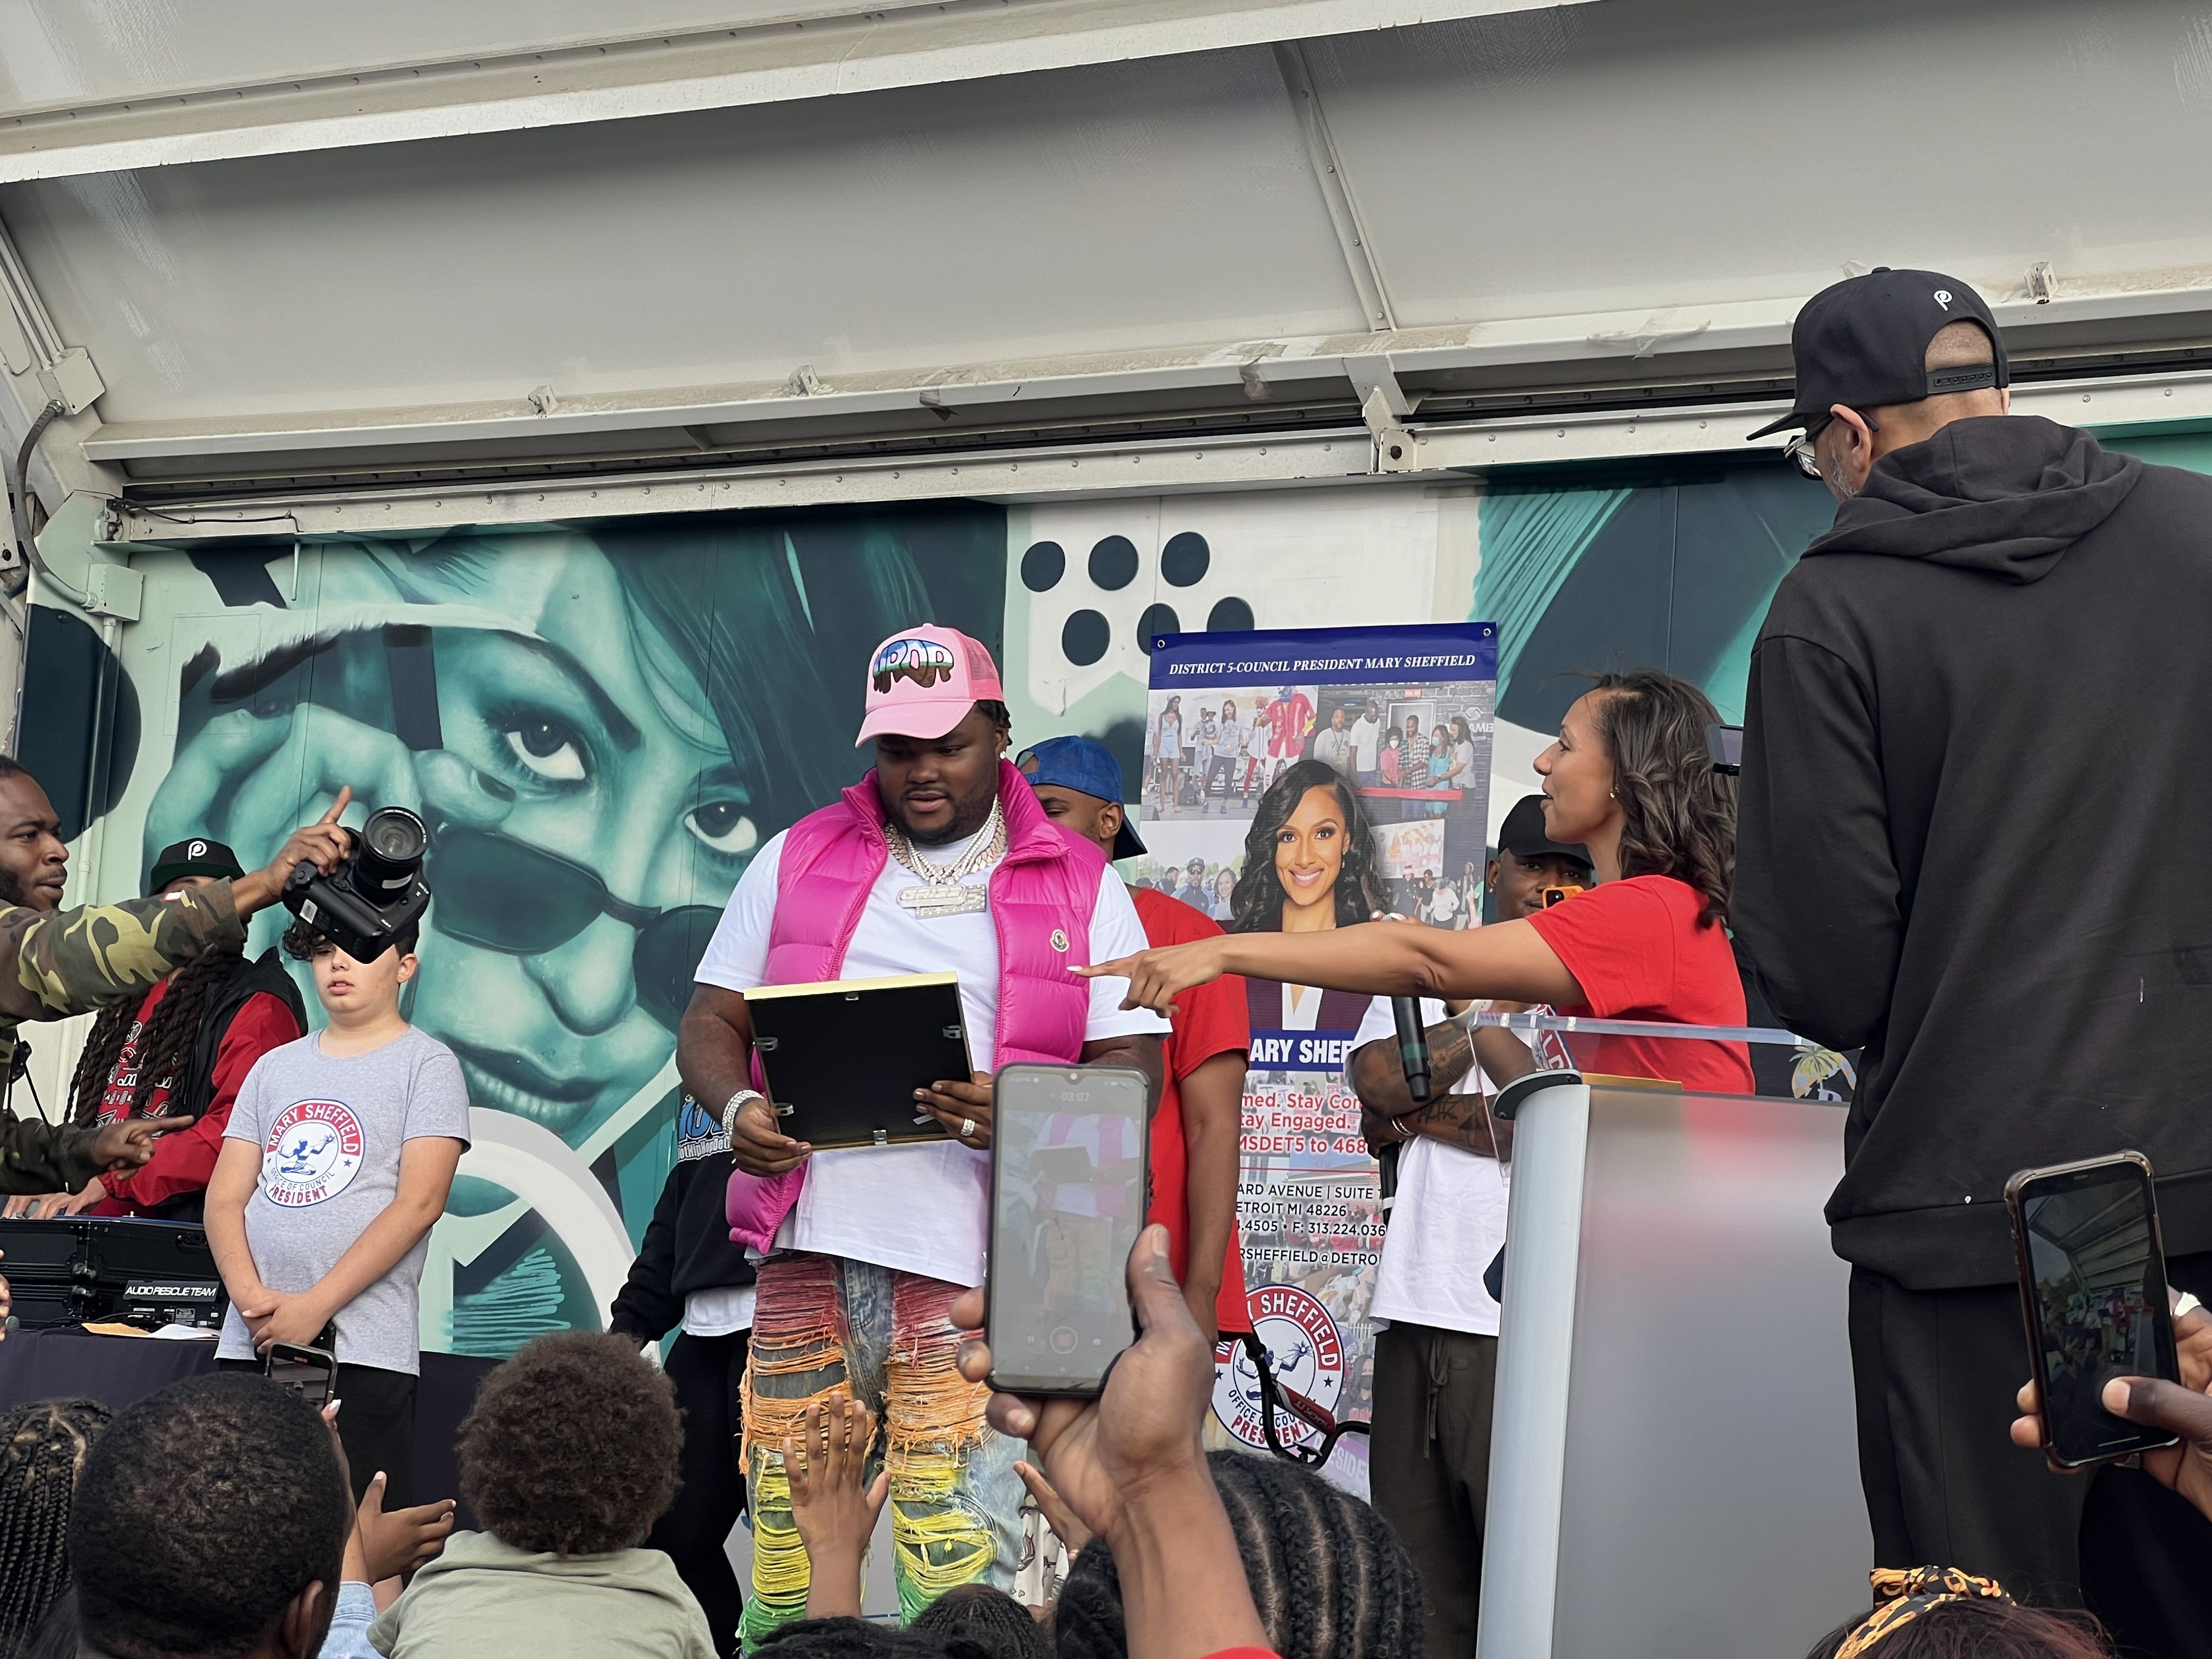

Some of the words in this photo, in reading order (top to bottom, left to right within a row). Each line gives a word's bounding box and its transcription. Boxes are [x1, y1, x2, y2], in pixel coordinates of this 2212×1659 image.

[1169, 662, 1226, 674] DISTRICT
[1227, 661, 1290, 673] 5-COUNCIL
[1293, 658, 1363, 671] PRESIDENT
[1364, 657, 1402, 669] MARY
[1404, 654, 1476, 668] SHEFFIELD
[1249, 1039, 1294, 1062] ARY
[1299, 1039, 1354, 1064] SHEF
[1242, 1093, 1280, 1107] med.
[1287, 1093, 1323, 1110] Stay
[1329, 1094, 1362, 1109] Con
[269, 1108, 299, 1147] MARY
[305, 1104, 359, 1153] SHEFFIELD
[1240, 1112, 1265, 1129] tay
[1271, 1113, 1351, 1131] Engaged.
[1310, 1138, 1327, 1152] to
[1333, 1138, 1366, 1153] 468
[300, 1171, 335, 1191] COUNCIL
[1238, 1184, 1264, 1195] ARD
[1268, 1185, 1322, 1198] AVENUE
[1335, 1187, 1373, 1199] SUITE
[1237, 1201, 1283, 1214] ETROIT
[1288, 1204, 1301, 1215] MI
[1306, 1204, 1346, 1217] 48226
[1293, 1222, 1304, 1233] F:
[1308, 1222, 1386, 1236] 313.224.036
[125, 1286, 154, 1295] AUDIO
[153, 1286, 190, 1296] RESCUE
[190, 1287, 216, 1296] TEAM
[1261, 1293, 1339, 1367] SHEFFIELD
[1228, 1390, 1257, 1425] OFFICE
[1231, 1414, 1310, 1445] PRESDENT
